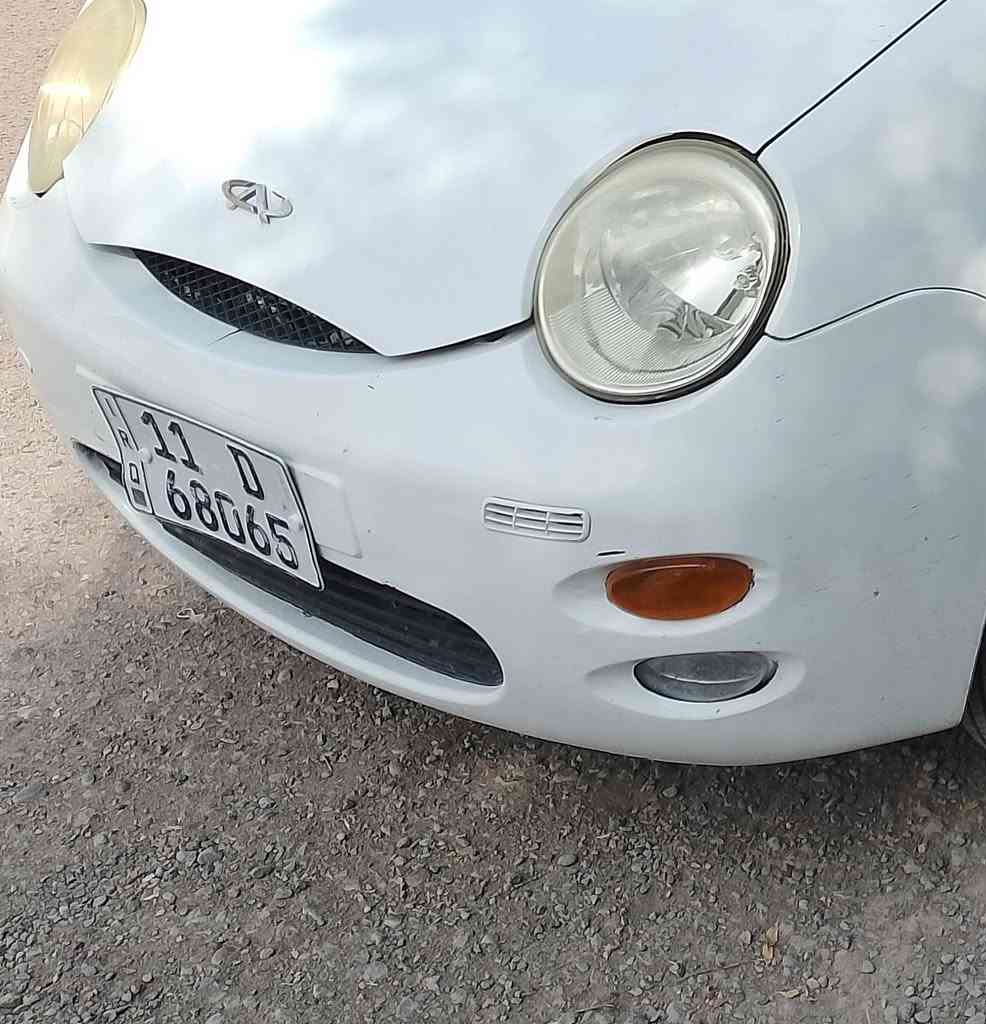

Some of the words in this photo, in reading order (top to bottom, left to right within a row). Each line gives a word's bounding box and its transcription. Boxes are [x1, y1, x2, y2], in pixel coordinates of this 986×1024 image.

[140, 410, 201, 474] 11
[226, 443, 265, 501] D
[166, 469, 299, 571] 68065
